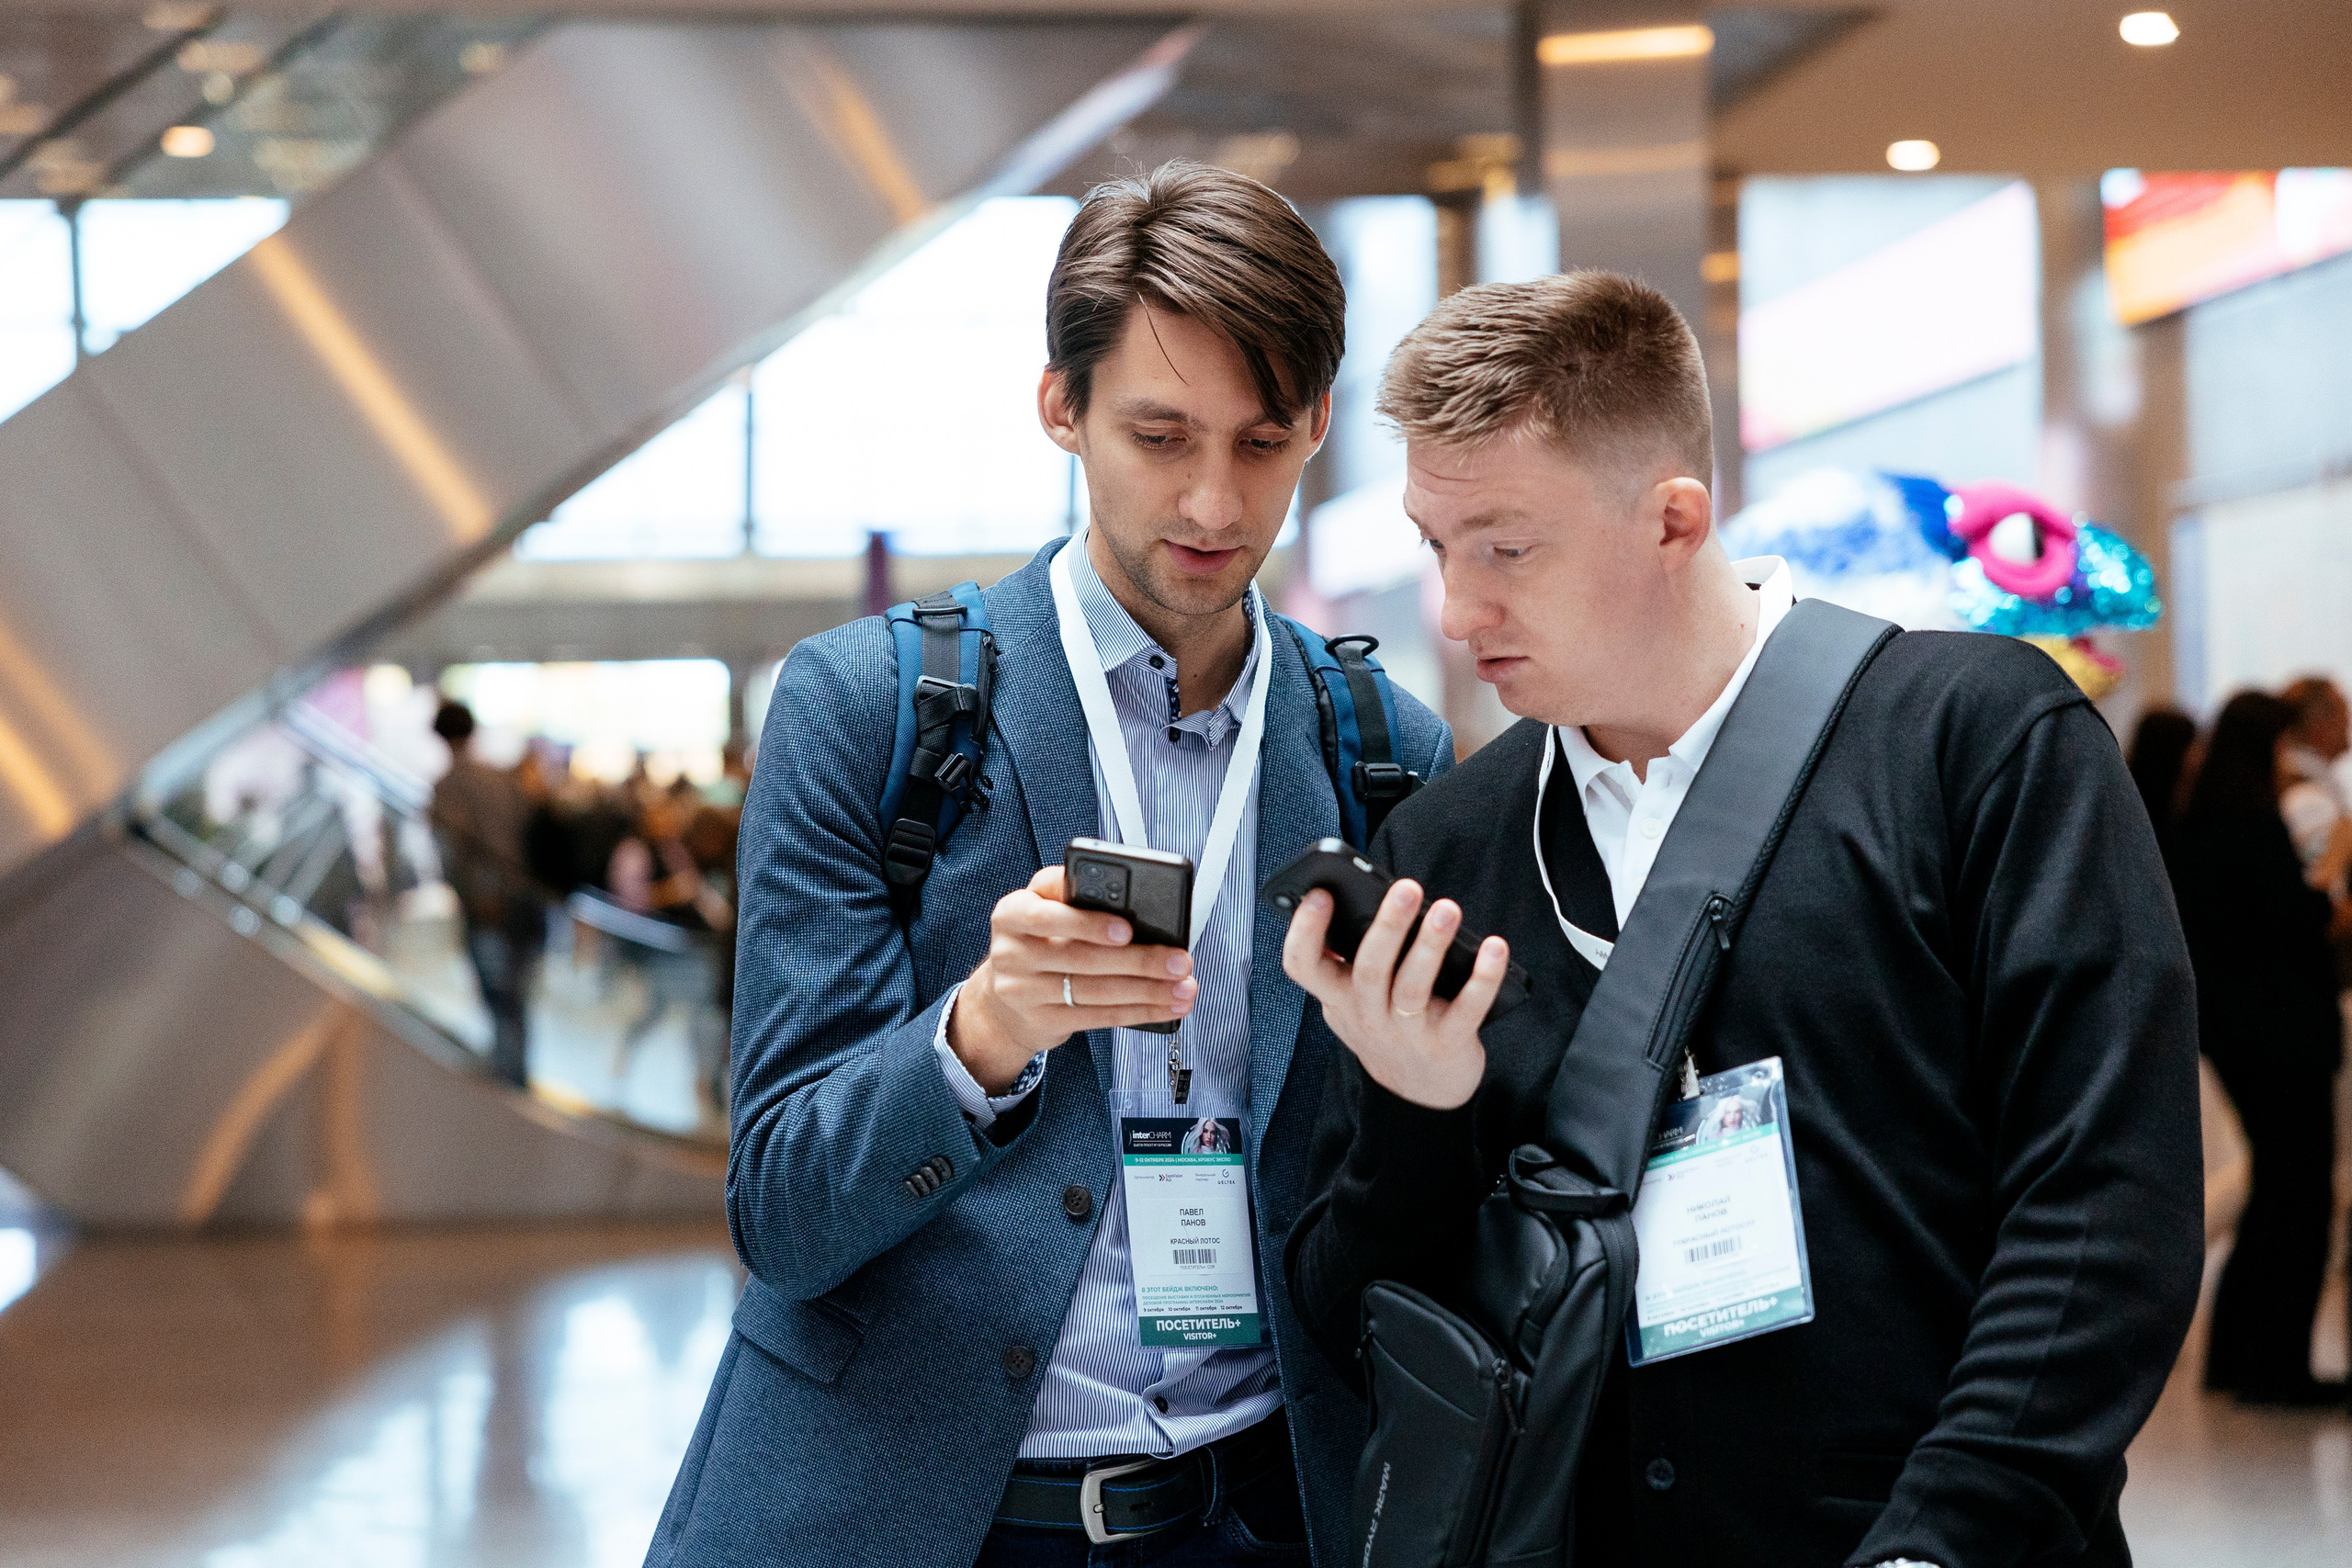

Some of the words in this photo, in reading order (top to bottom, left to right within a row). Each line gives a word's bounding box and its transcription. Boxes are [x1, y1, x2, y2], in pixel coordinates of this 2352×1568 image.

[1132, 1130, 1171, 1139] interCHARM
[1695, 1208, 1727, 1223] ПАНОВ
[1663, 1296, 1779, 1337] ПОСЕТИТЕЛЬ+
[1156, 1318, 1241, 1331] ПОСЕТИТЕЛЬ+
[1183, 1332, 1216, 1340] VISITOR+
[1374, 1461, 1391, 1517] MARK
